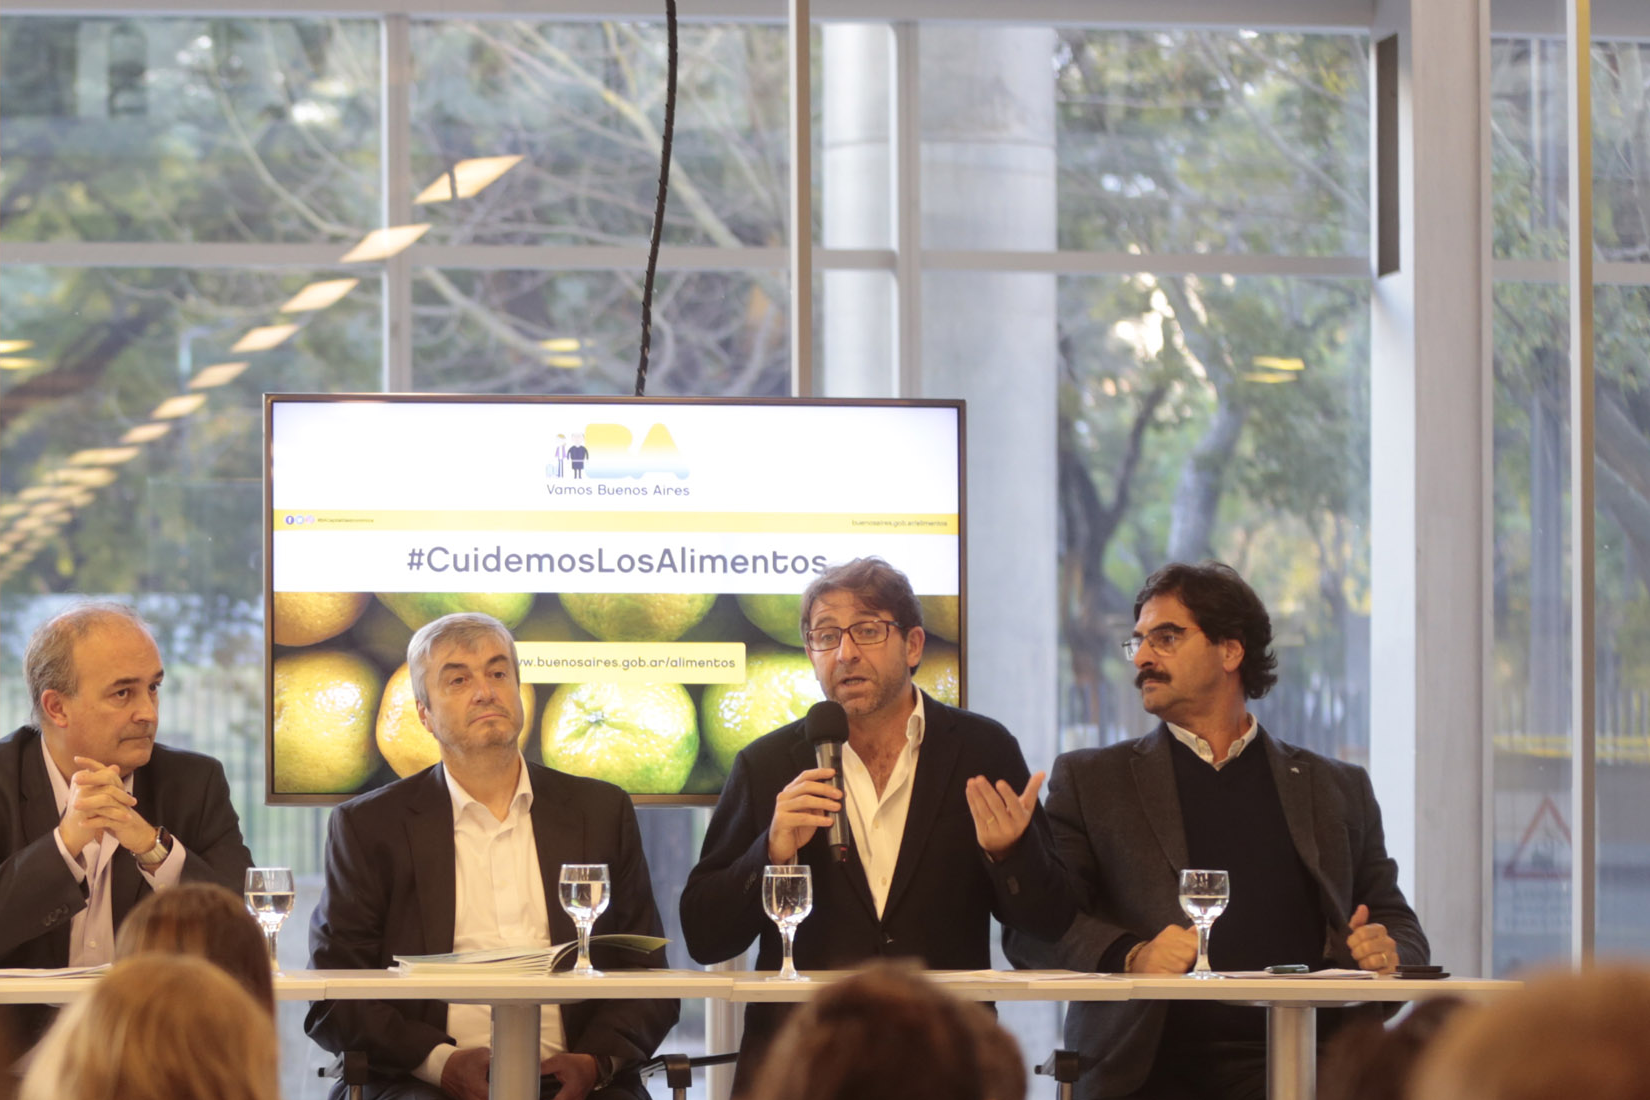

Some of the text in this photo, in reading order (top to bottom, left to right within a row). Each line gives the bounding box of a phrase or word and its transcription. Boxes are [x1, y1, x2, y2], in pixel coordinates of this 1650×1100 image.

[584, 423, 690, 480] BA
[547, 484, 691, 496] Vamos Buenos Aires
[407, 546, 828, 575] #CuidemosLosAlimentos
